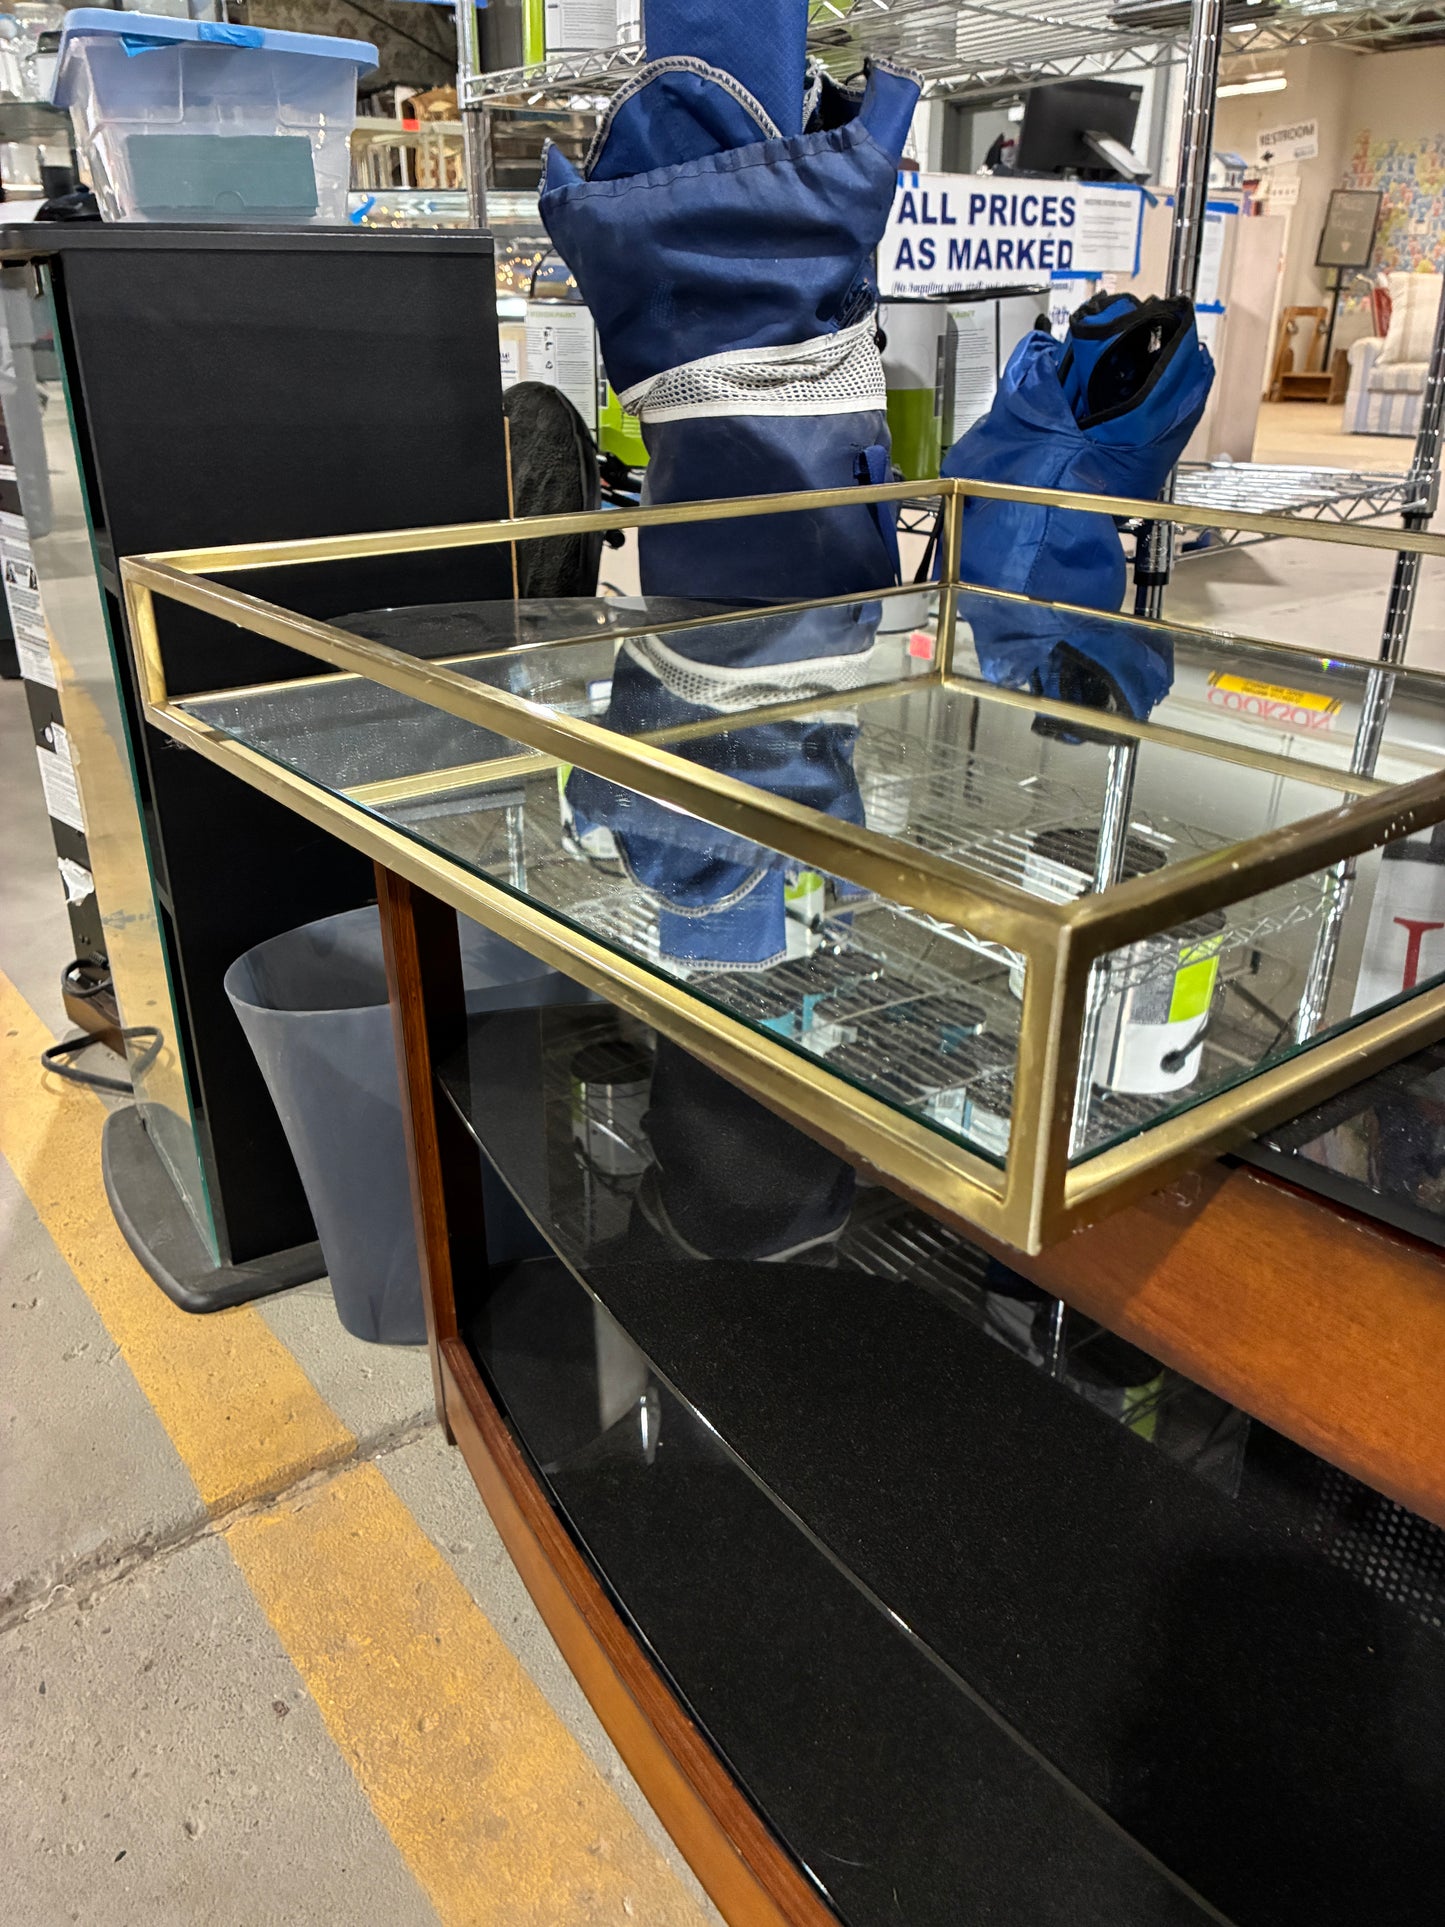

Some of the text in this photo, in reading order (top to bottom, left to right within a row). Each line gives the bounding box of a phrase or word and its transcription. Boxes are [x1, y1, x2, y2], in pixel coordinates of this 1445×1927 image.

[1259, 124, 1315, 146] RESTROOM
[897, 191, 1076, 228] ALL PRICES
[894, 238, 1073, 271] AS MARKED
